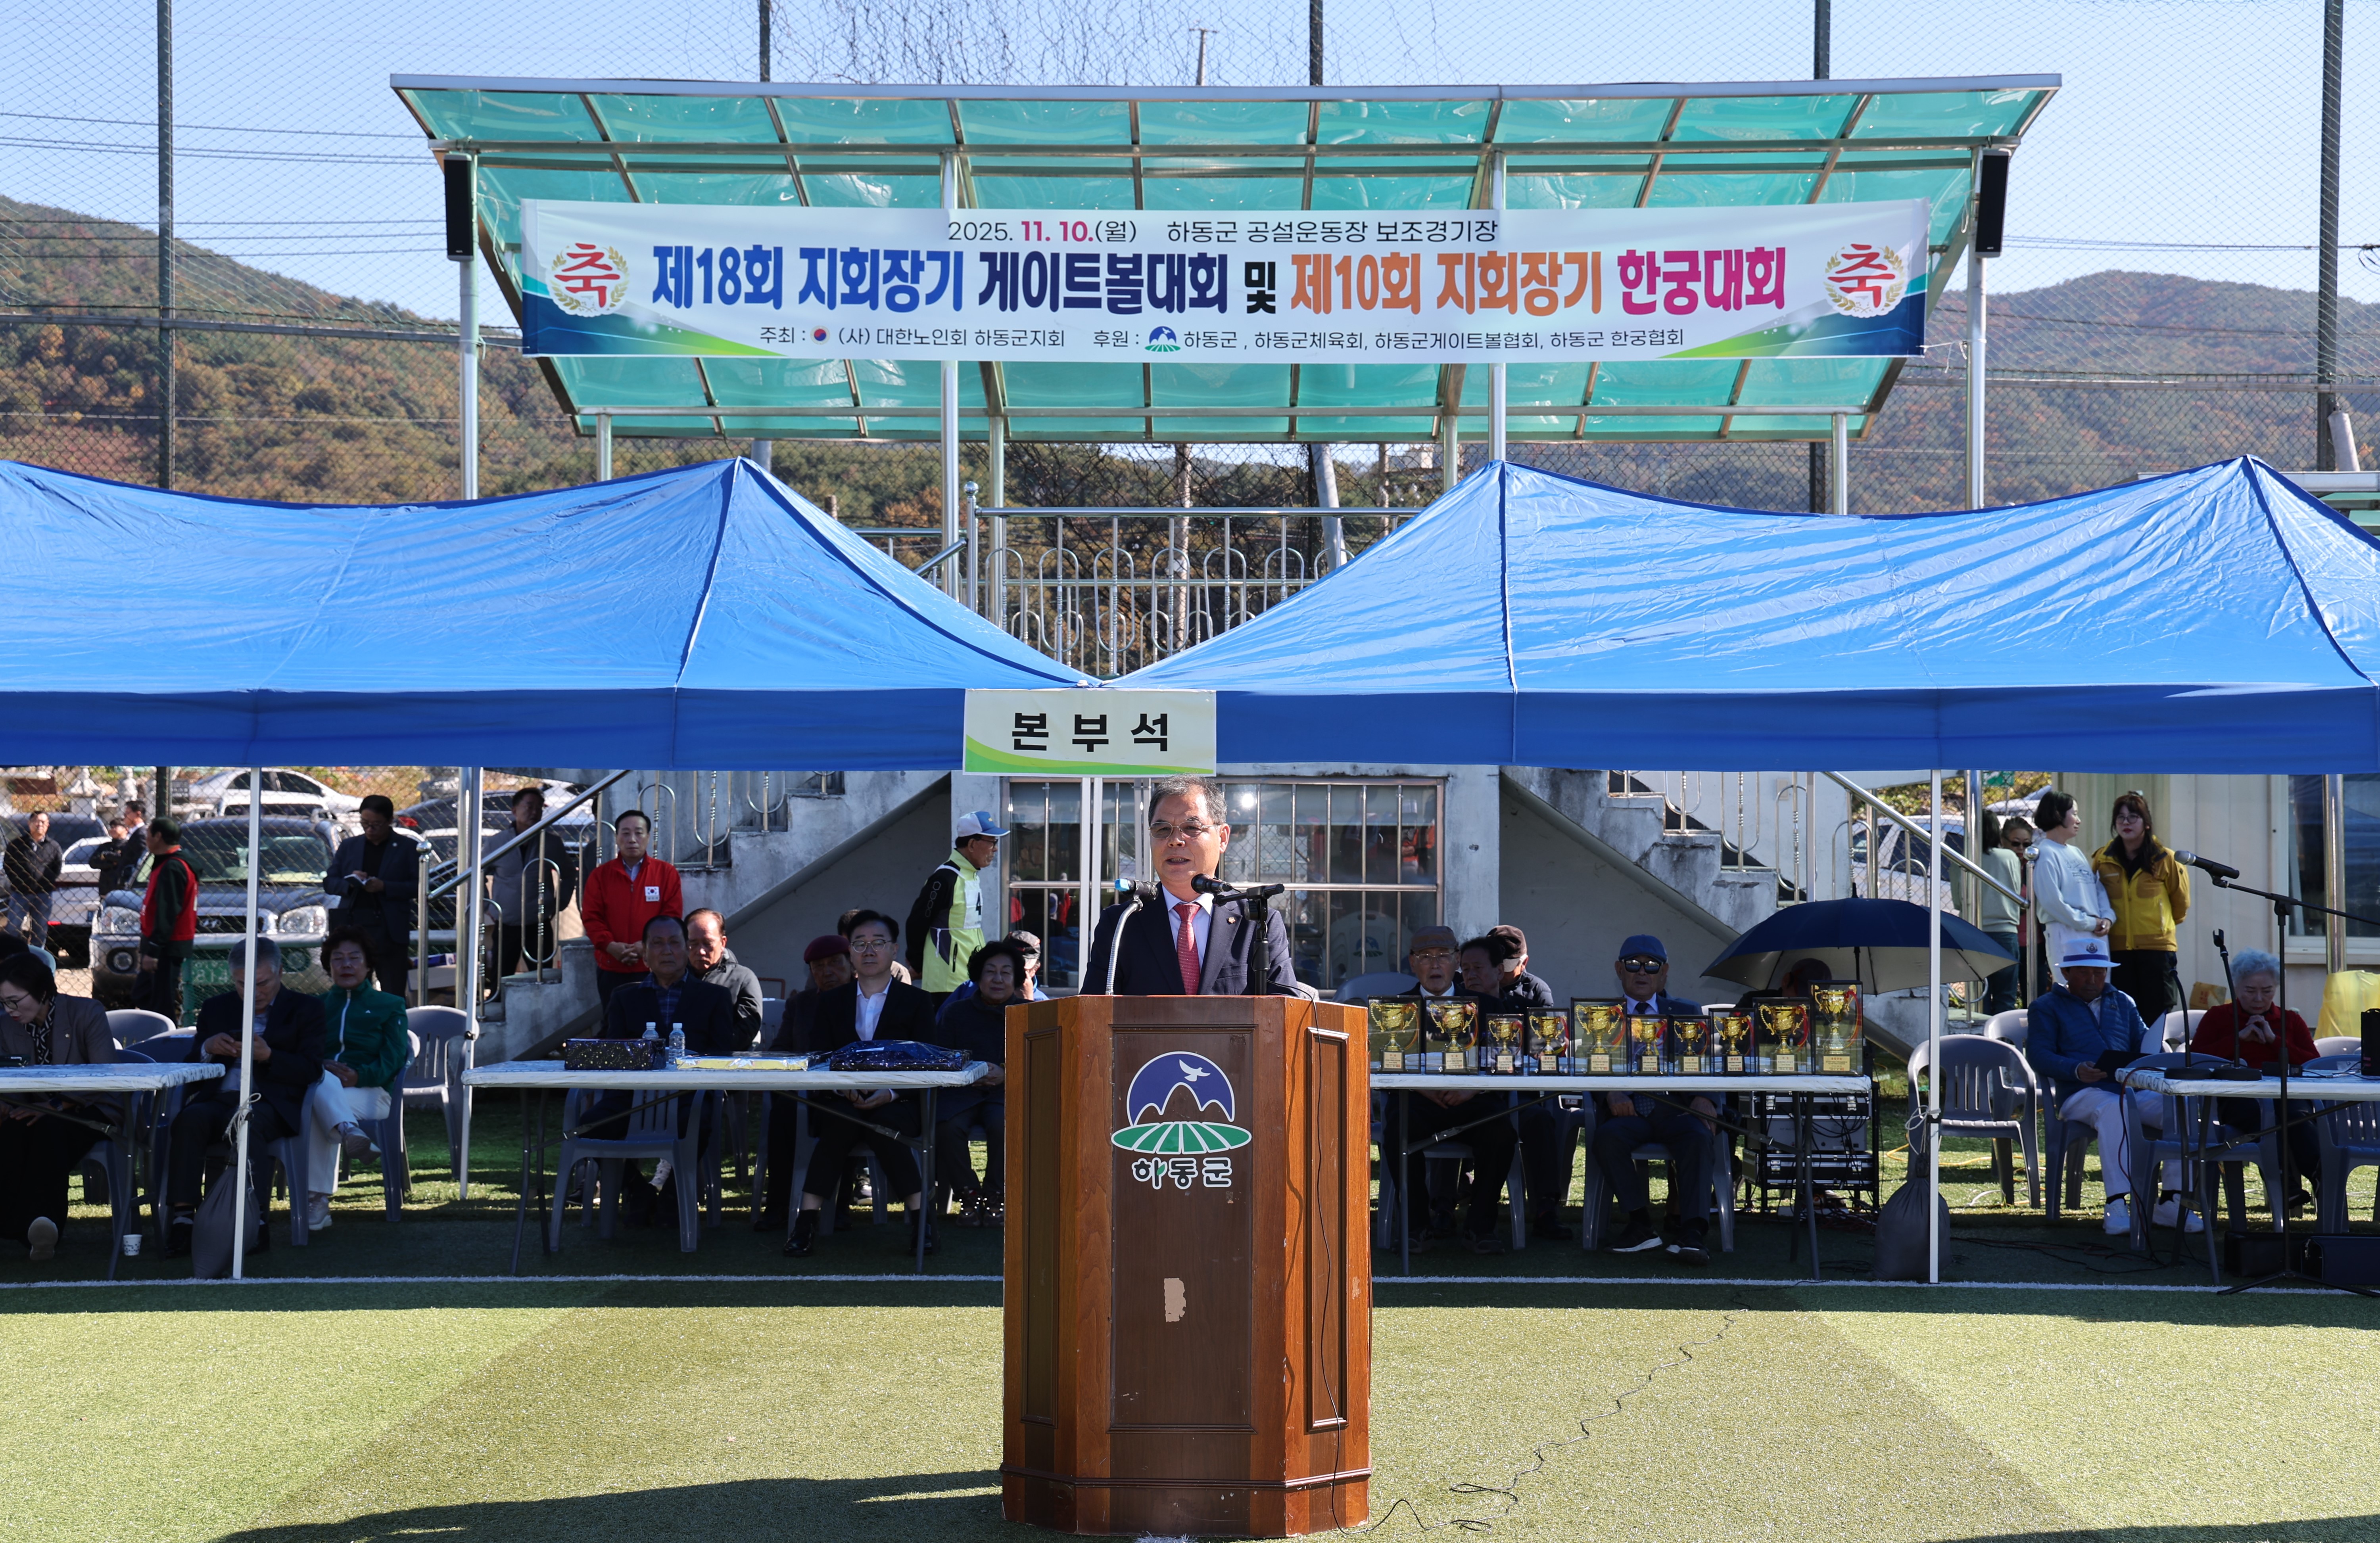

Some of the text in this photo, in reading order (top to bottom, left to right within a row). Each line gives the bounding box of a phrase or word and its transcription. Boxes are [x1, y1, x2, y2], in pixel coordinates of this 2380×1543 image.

[947, 222, 1013, 242] 2025.
[1021, 221, 1051, 242] 11.
[1167, 221, 1238, 243] 하동군
[1247, 221, 1368, 243] 공설운동장
[1376, 220, 1499, 243] 보조경기장
[555, 243, 620, 307] 축
[653, 245, 1785, 316] 제18회 지회장기 게이트볼대회 및 제10회 지회장기 한궁대회
[1827, 244, 1895, 308] 축
[760, 327, 795, 344] 주최
[838, 328, 870, 345] (사)
[876, 328, 967, 346] 대한노인회
[974, 329, 1064, 347] 하동군지회
[1093, 330, 1129, 348] 후원
[1183, 331, 1238, 349] 하동군
[1254, 332, 1368, 351] 하동군체육회,
[1374, 332, 1543, 350] 하동군게이트볼협회,
[1550, 332, 1605, 348] 하동군
[1610, 329, 1683, 347] 한궁협회
[975, 891, 982, 916] 4
[1132, 1157, 1232, 1190] 하동군
